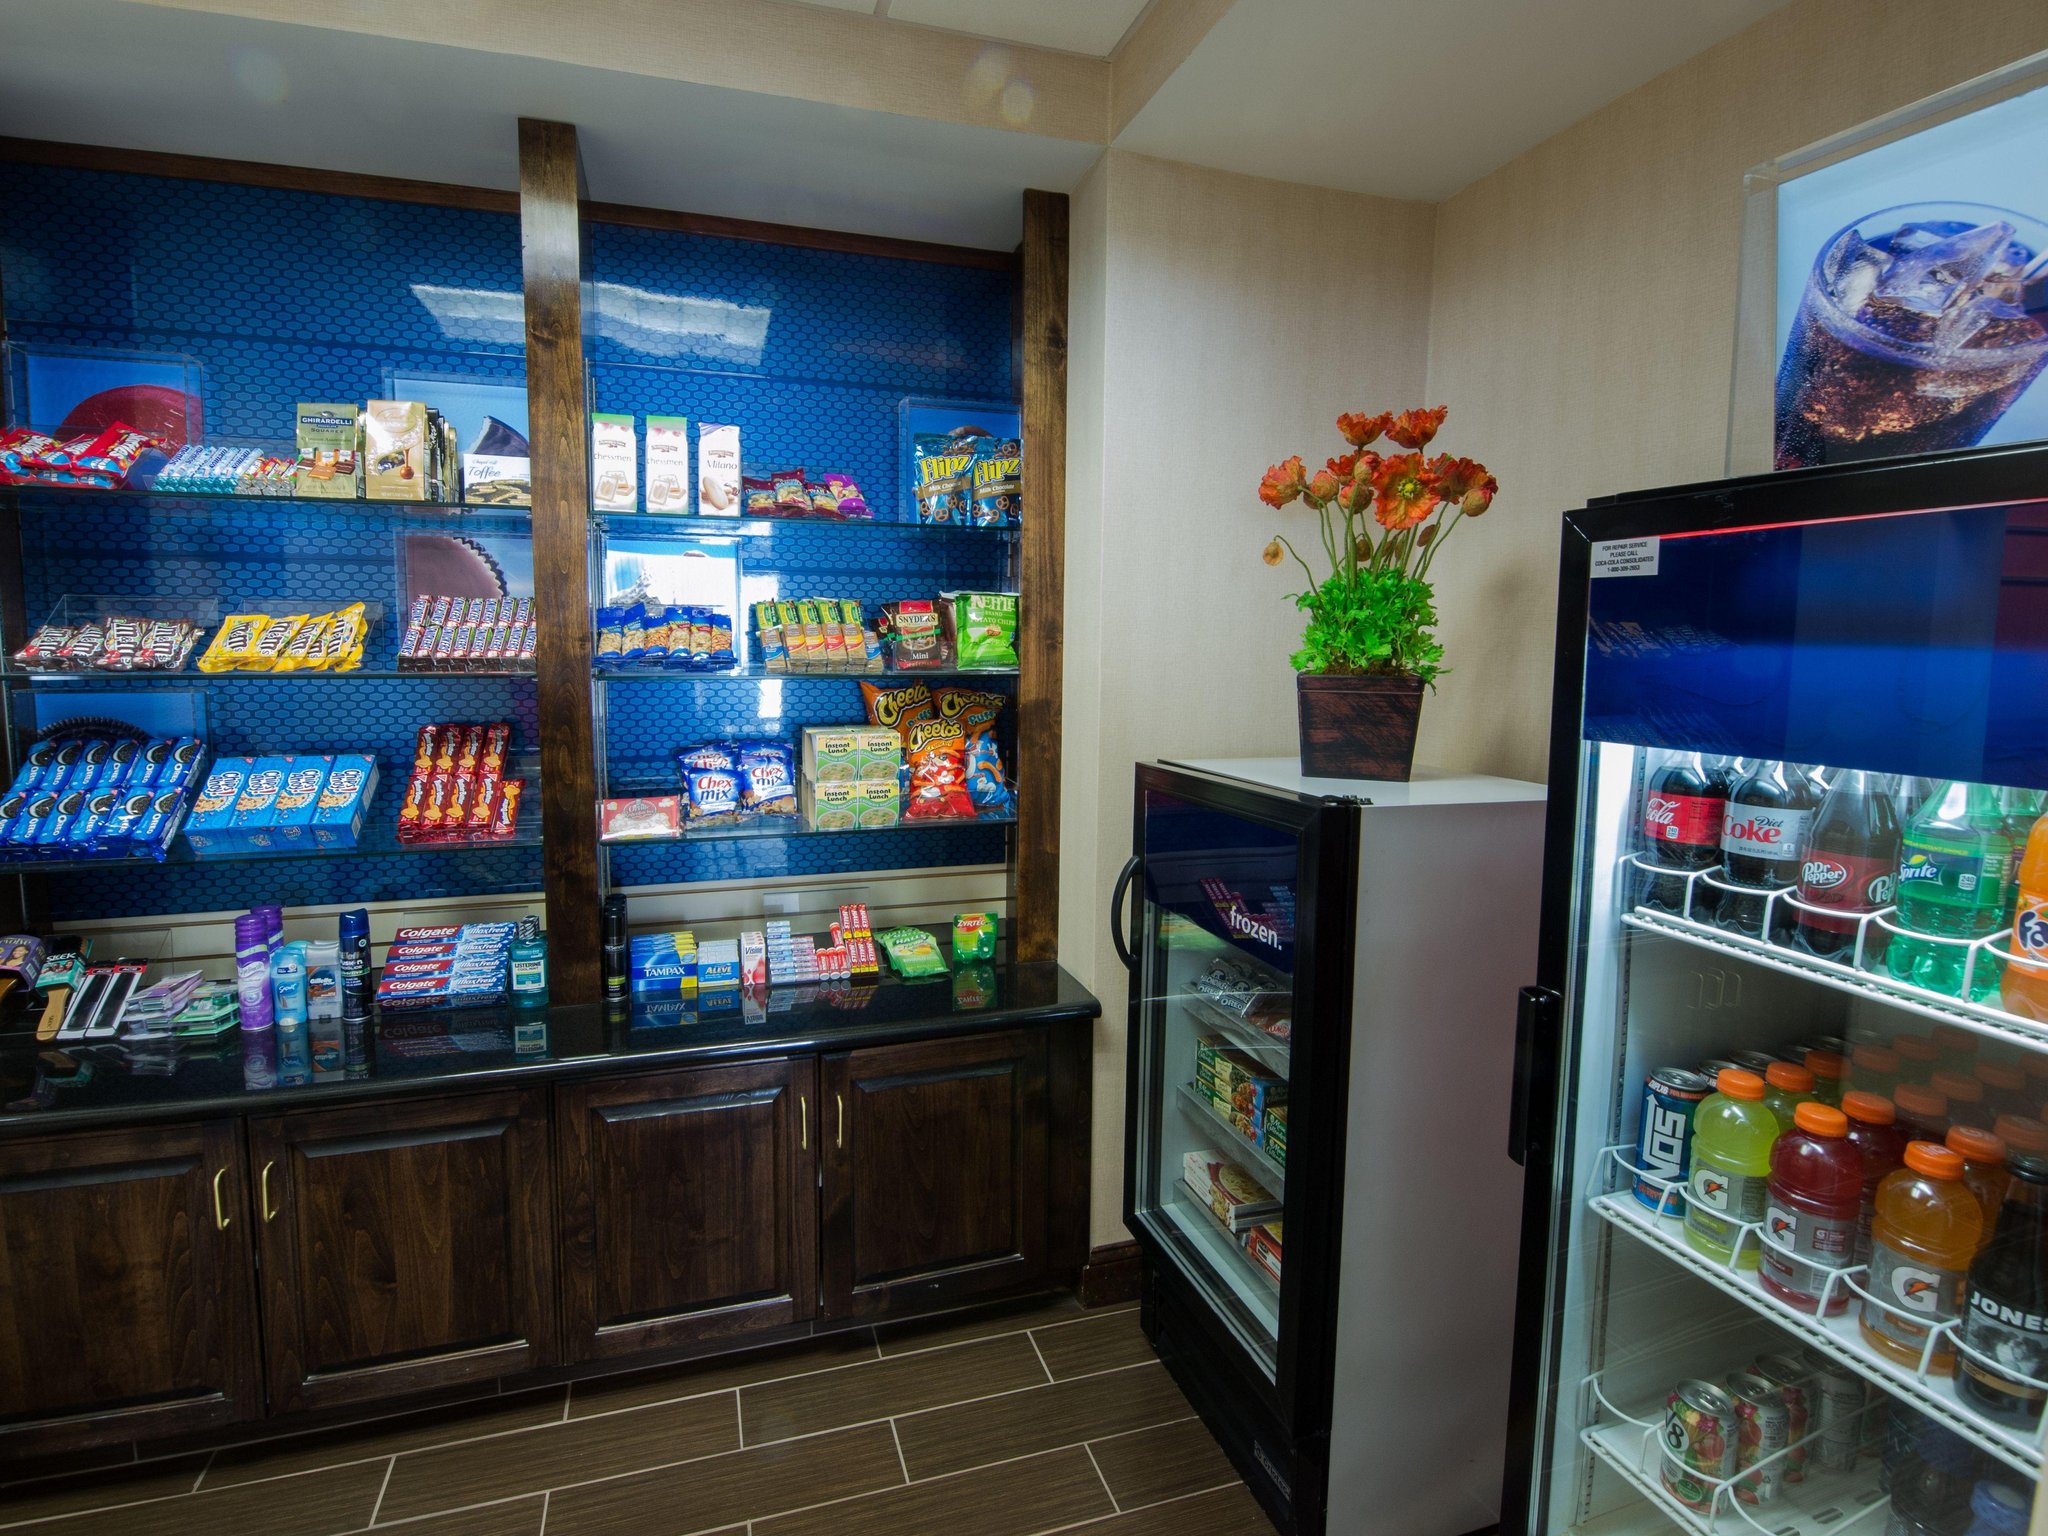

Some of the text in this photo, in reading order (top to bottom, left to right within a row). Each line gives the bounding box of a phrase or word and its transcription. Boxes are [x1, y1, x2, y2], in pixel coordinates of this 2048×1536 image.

[302, 417, 352, 426] GHIRARDELLI
[706, 460, 738, 470] Milano
[921, 456, 969, 485] Flipz
[468, 466, 501, 479] Toffee
[974, 458, 1020, 487] Flipz
[1620, 555, 1655, 564] CONSOLIDATED
[912, 652, 929, 660] Mini
[909, 721, 961, 751] Cheetos
[169, 763, 183, 783] OREO
[752, 767, 783, 778] Chex
[697, 776, 733, 790] Chex
[756, 773, 784, 787] mix
[700, 788, 732, 801] mix
[53, 815, 67, 836] OREO
[146, 813, 162, 835] OREO
[1754, 815, 1784, 828] Diet
[1722, 814, 1782, 844] Coke
[1802, 862, 1842, 884] Pepper
[1814, 862, 1831, 873] Dr
[1899, 864, 1938, 882] Sprite
[1960, 875, 1976, 883] 240
[957, 919, 986, 928] ZYRTEC
[1230, 905, 1282, 951] frozen.
[400, 927, 457, 939] Colgate
[2018, 910, 2048, 951] Fa
[398, 945, 445, 955] Colgate
[393, 962, 441, 973] Colgate
[643, 966, 685, 978] TAMPAX
[389, 979, 438, 990] Colgate
[1221, 998, 1243, 1010] OREO
[1694, 1169, 1729, 1210] G
[1761, 1206, 1797, 1251] G
[1891, 1266, 1941, 1312] G
[1970, 1290, 2048, 1333] JONE
